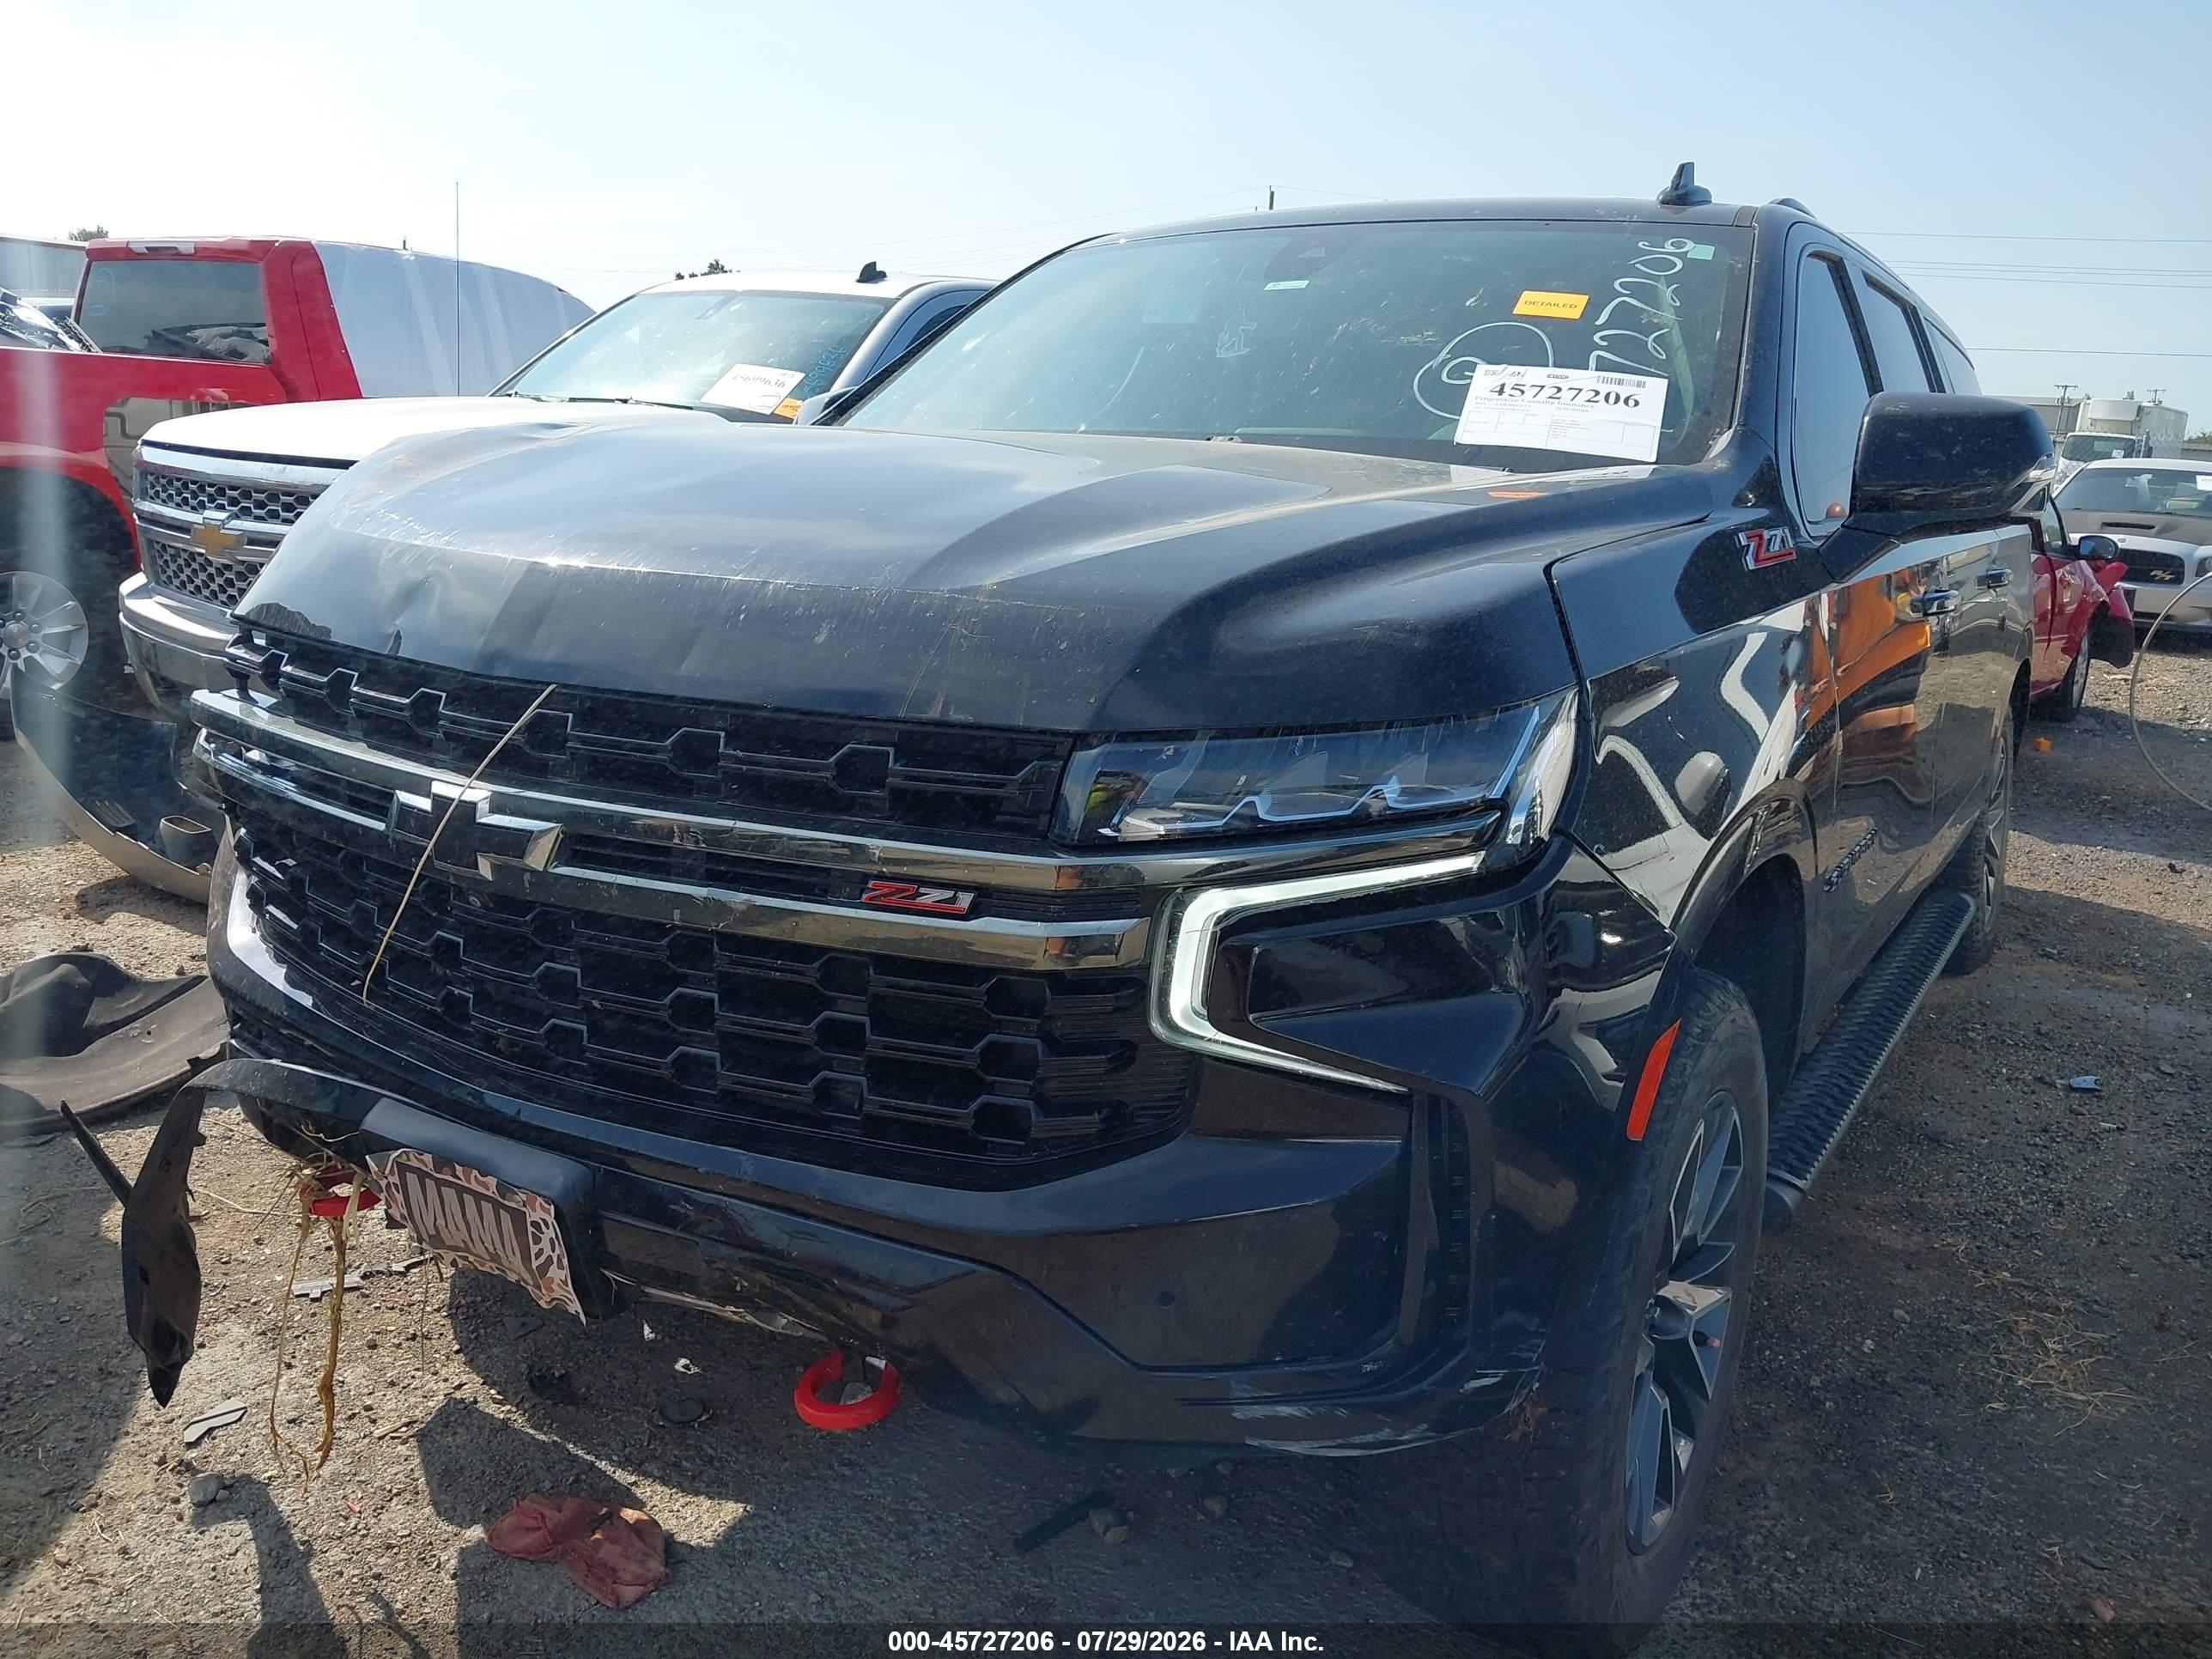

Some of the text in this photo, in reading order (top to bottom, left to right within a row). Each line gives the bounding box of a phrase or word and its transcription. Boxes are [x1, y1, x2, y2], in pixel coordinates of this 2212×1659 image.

[1523, 301, 1577, 309] DETAILED
[1489, 382, 1643, 408] 45727206
[1738, 526, 1797, 570] Z71
[860, 880, 975, 915] Z71
